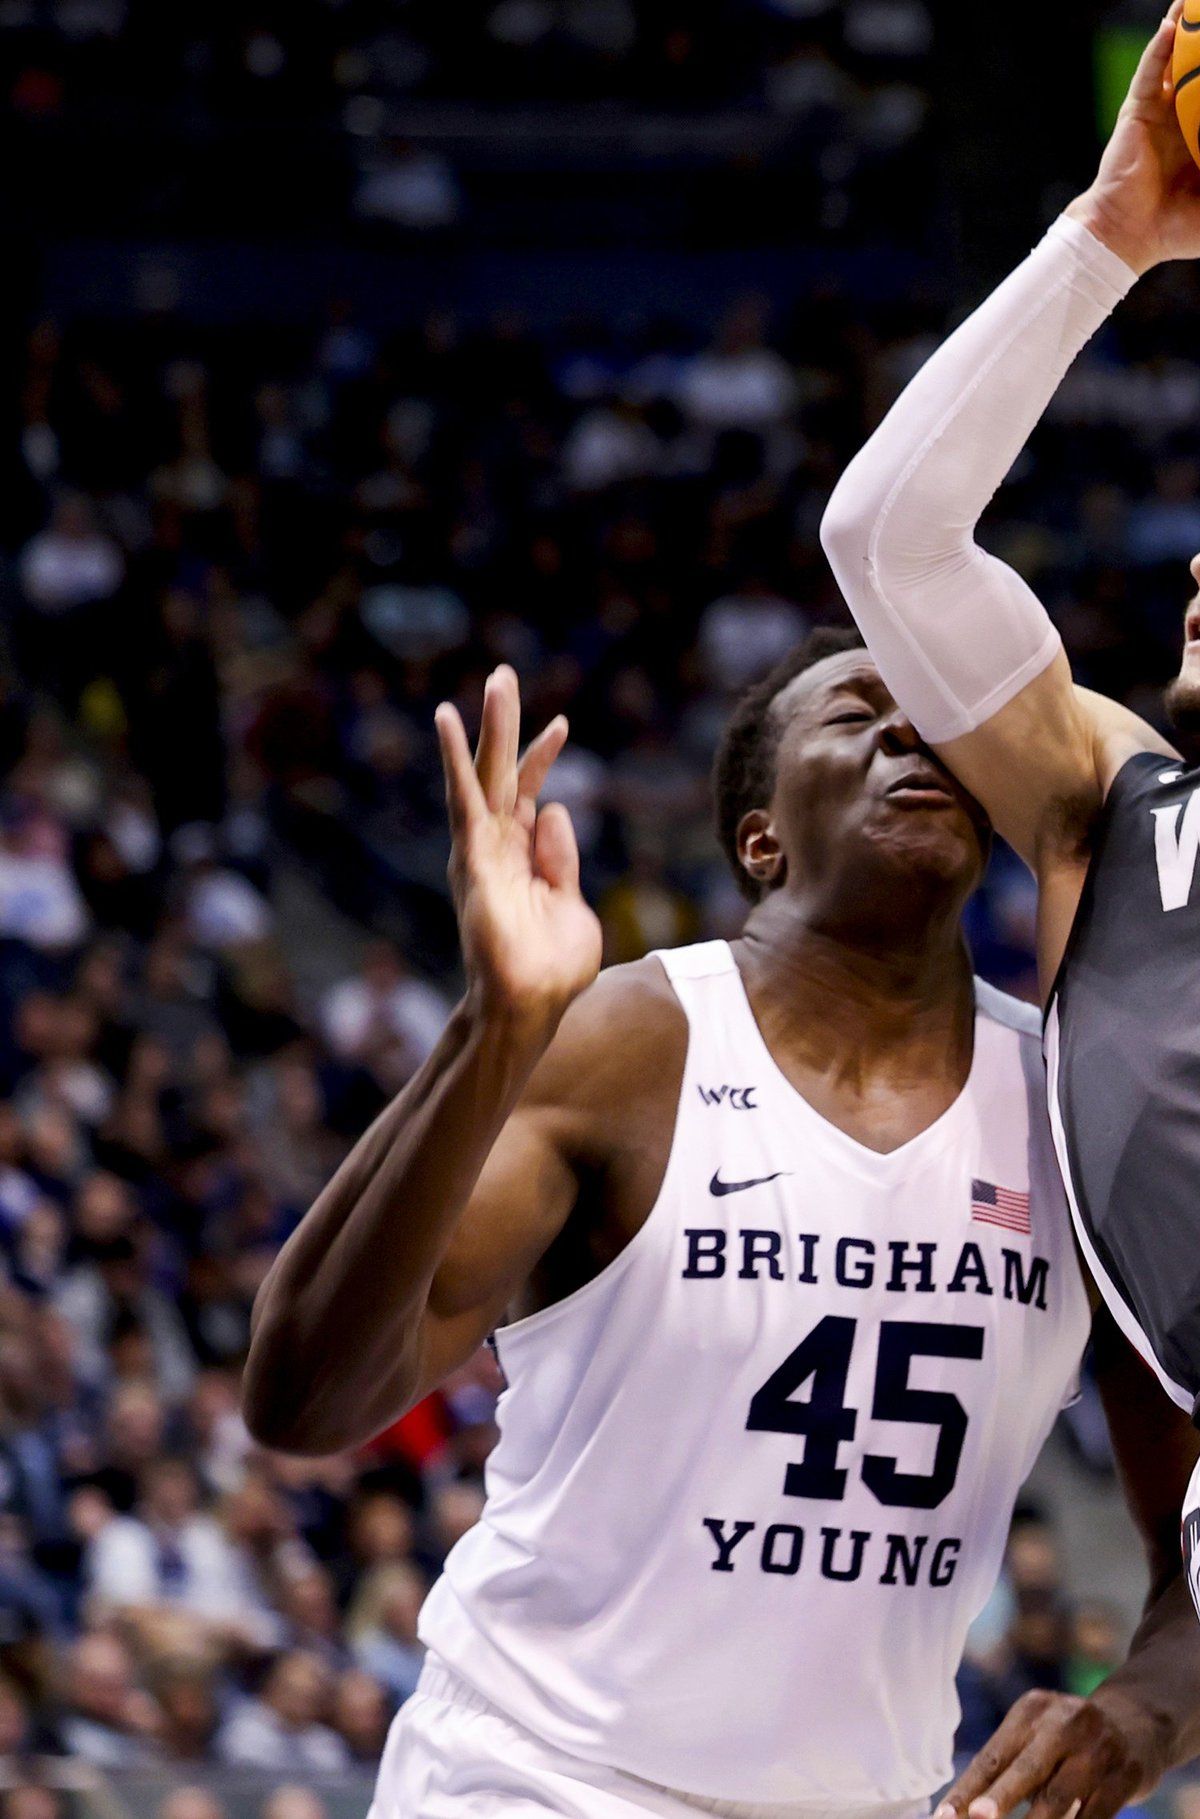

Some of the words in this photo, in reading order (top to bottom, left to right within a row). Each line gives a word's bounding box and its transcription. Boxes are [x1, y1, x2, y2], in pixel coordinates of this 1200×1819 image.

[698, 1084, 757, 1110] WCC
[682, 1229, 1050, 1311] BRIGHAM
[746, 1315, 985, 1509] 45
[703, 1518, 961, 1587] YOUNG
